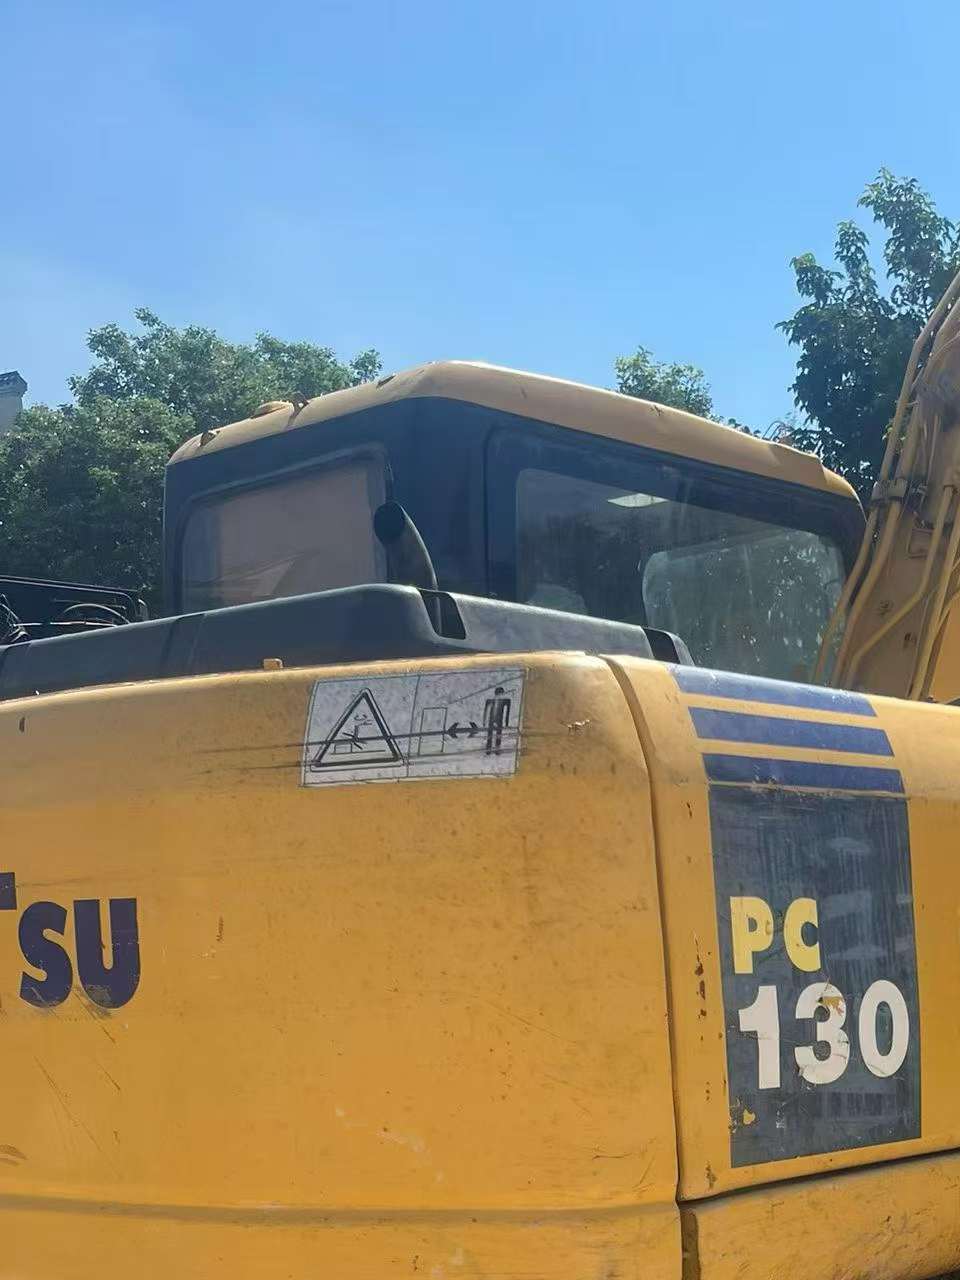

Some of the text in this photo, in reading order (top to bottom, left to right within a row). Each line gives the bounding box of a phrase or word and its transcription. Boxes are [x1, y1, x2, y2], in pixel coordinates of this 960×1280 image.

[0, 872, 141, 1009] SU
[729, 896, 822, 974] PC
[738, 979, 910, 1089] 130
